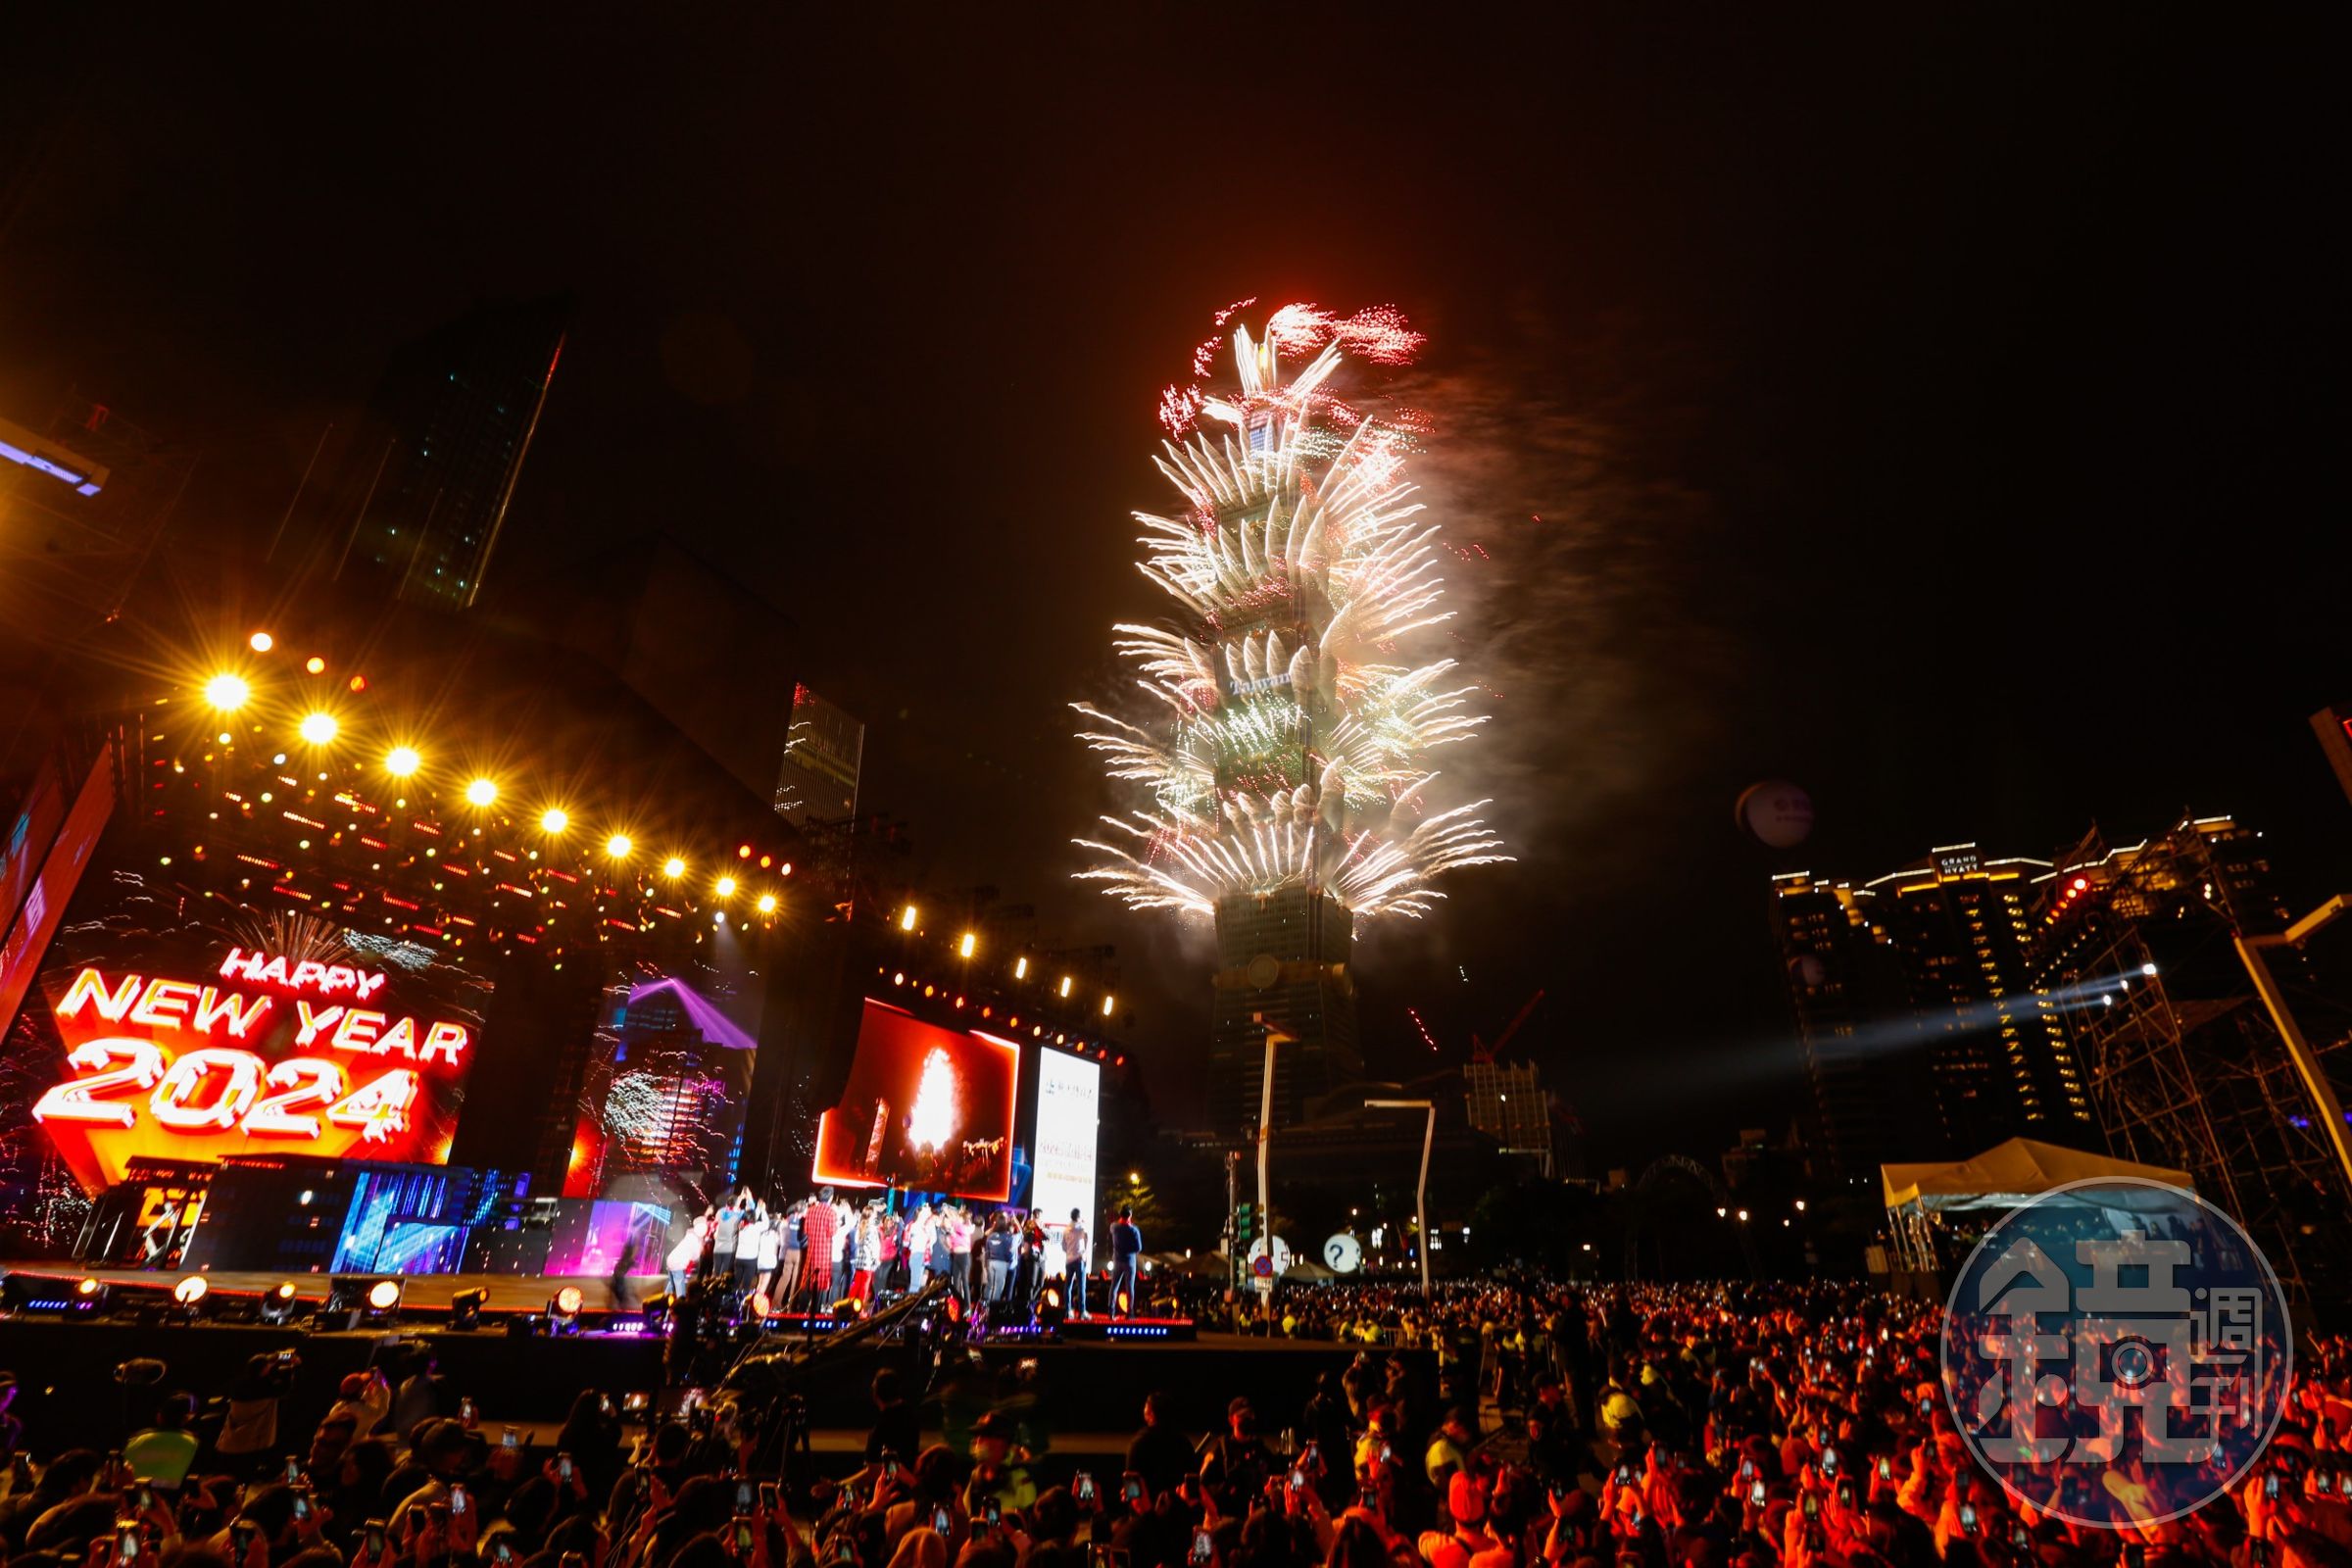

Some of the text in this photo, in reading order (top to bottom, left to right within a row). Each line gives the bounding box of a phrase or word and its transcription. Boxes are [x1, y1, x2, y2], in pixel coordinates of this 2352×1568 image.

[1941, 855, 1977, 865] GRAND
[1944, 863, 1978, 874] HYATT
[219, 947, 385, 1000] HAPPY
[56, 967, 467, 1066] NEW YEAR
[32, 1037, 419, 1143] 2024
